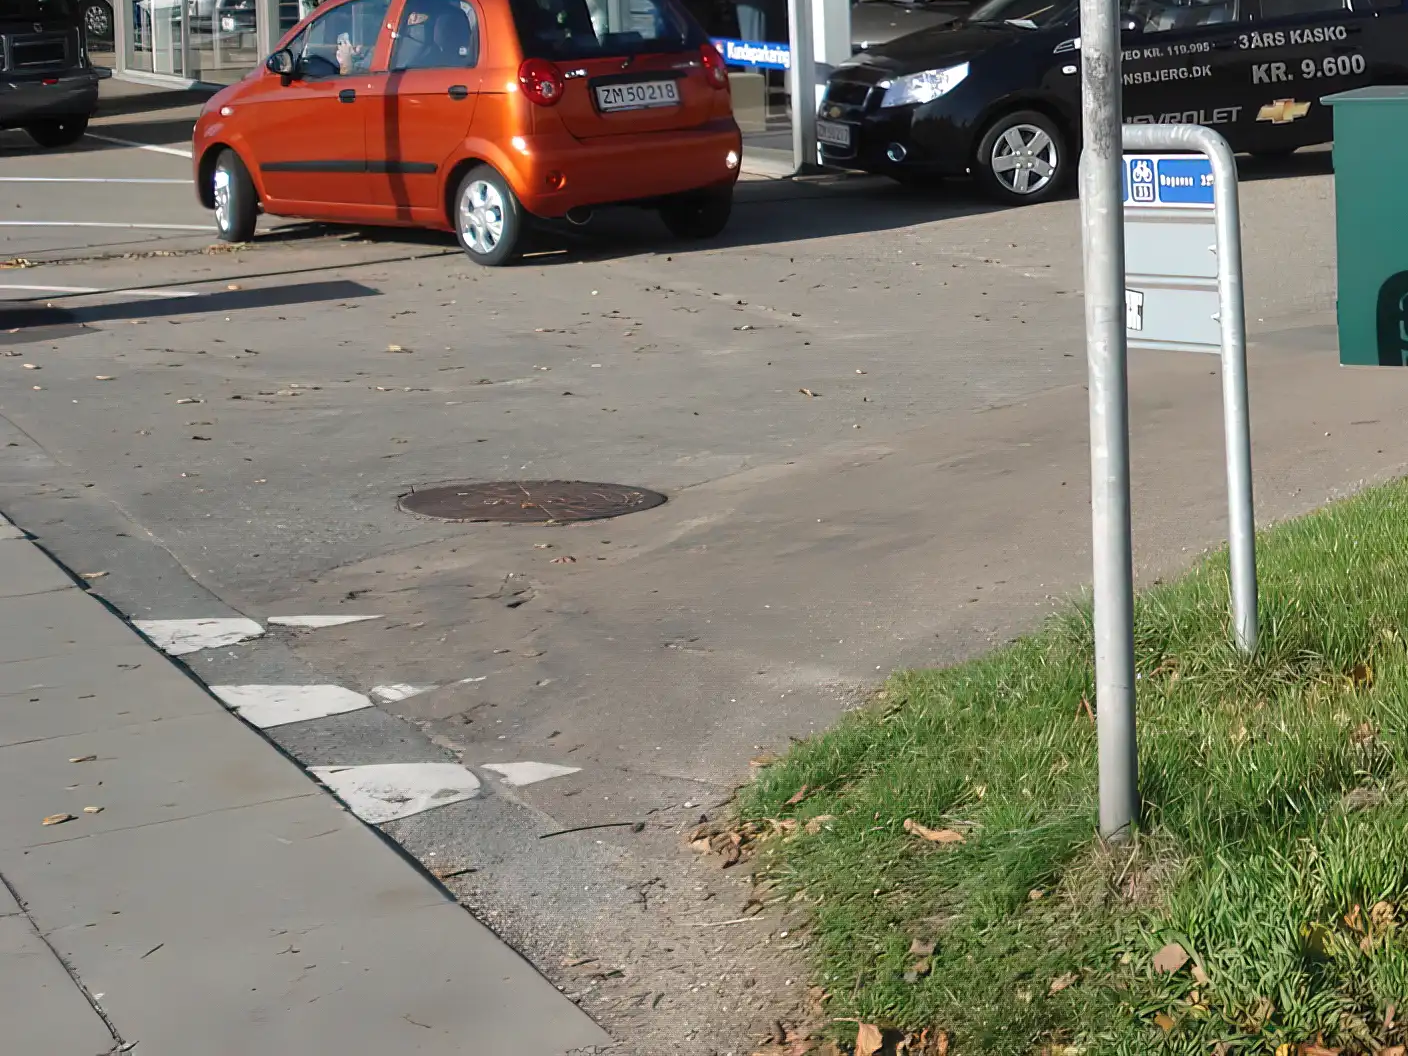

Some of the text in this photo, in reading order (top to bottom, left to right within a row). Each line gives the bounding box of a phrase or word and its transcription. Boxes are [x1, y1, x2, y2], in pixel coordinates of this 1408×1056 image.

[1290, 25, 1348, 45] KASKO
[1120, 64, 1212, 86] NSBJERG.DK
[1252, 54, 1366, 85] KR. 9.600
